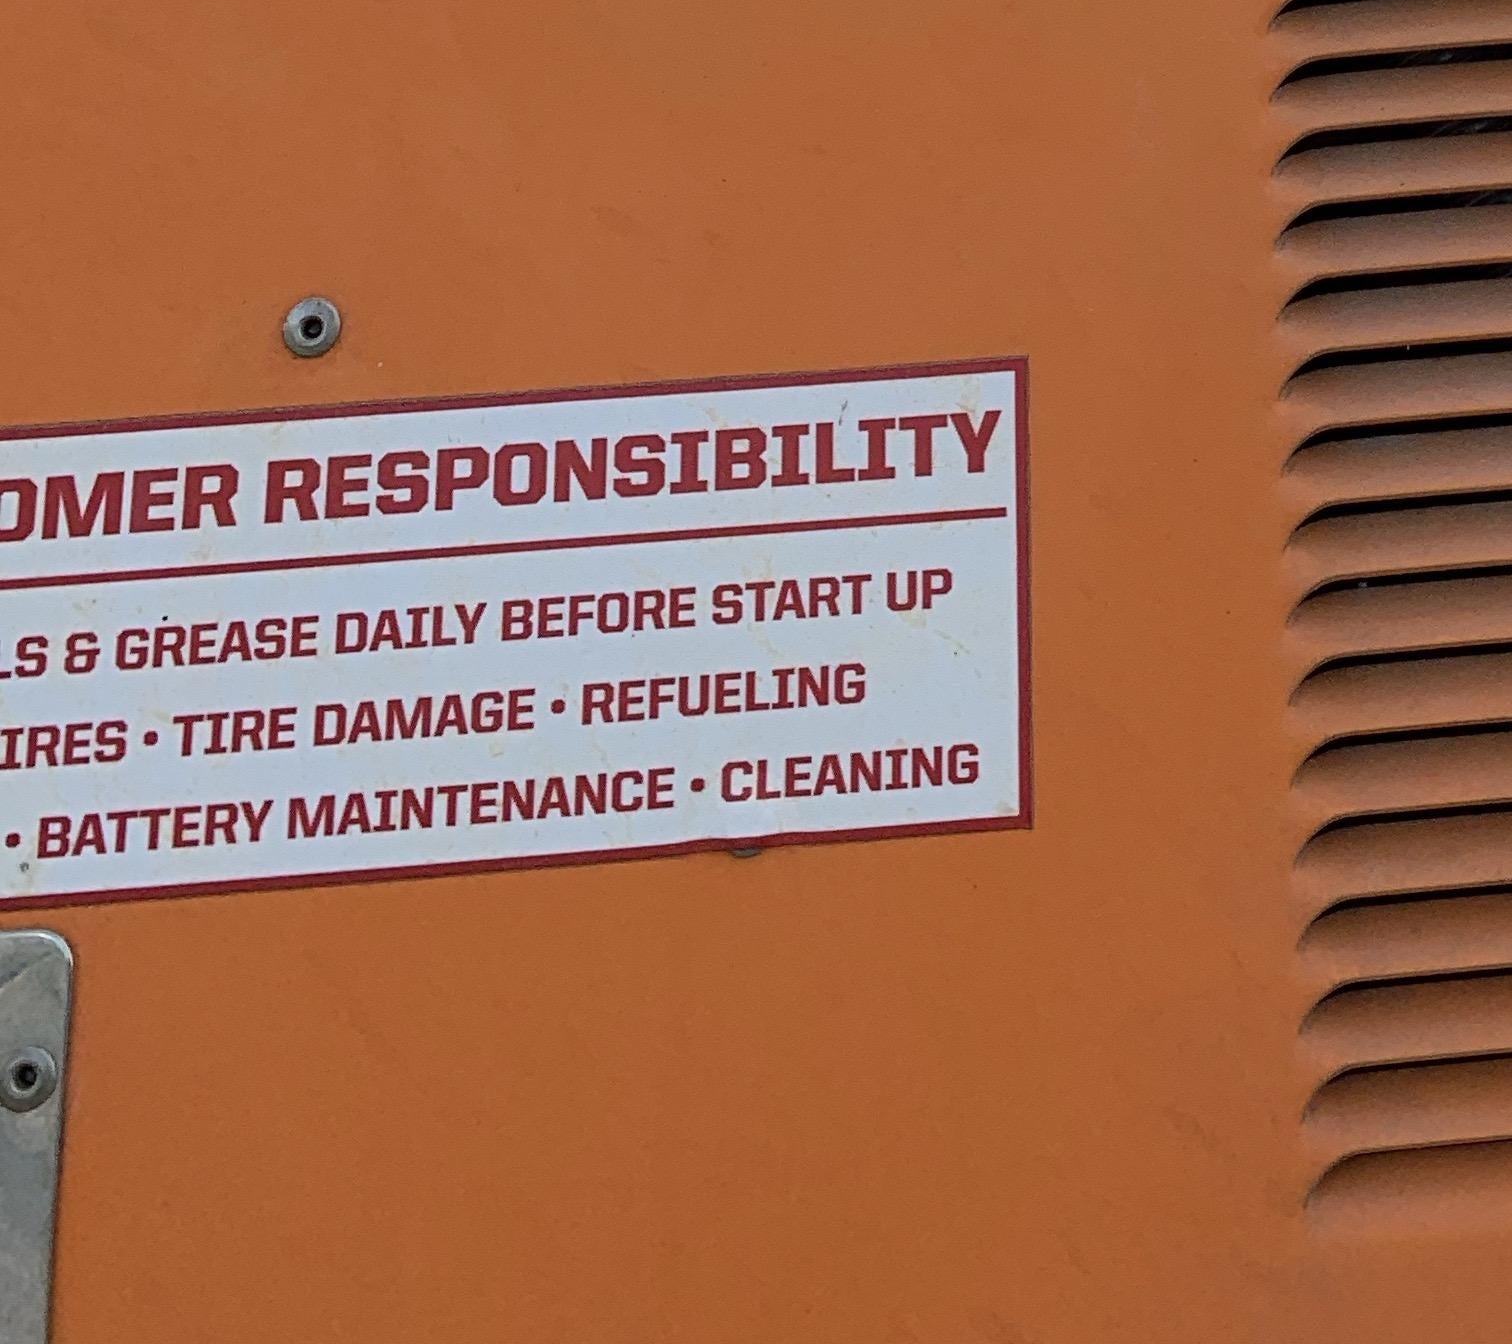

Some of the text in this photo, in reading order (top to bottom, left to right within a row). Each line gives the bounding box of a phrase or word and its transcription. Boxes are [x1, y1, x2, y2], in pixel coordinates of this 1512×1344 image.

[0, 409, 1002, 542] OMER RESPONSIBILITY
[63, 631, 101, 675] &
[115, 615, 320, 671] GREASE
[335, 602, 488, 655] DAILY
[501, 586, 697, 642] BEFORE
[712, 573, 874, 625] START
[886, 568, 954, 612] UP
[0, 662, 867, 771] IRES TIRE DAMAGE REFUELING
[36, 743, 980, 859] BATTERY MAINTENANCE CLEANING
